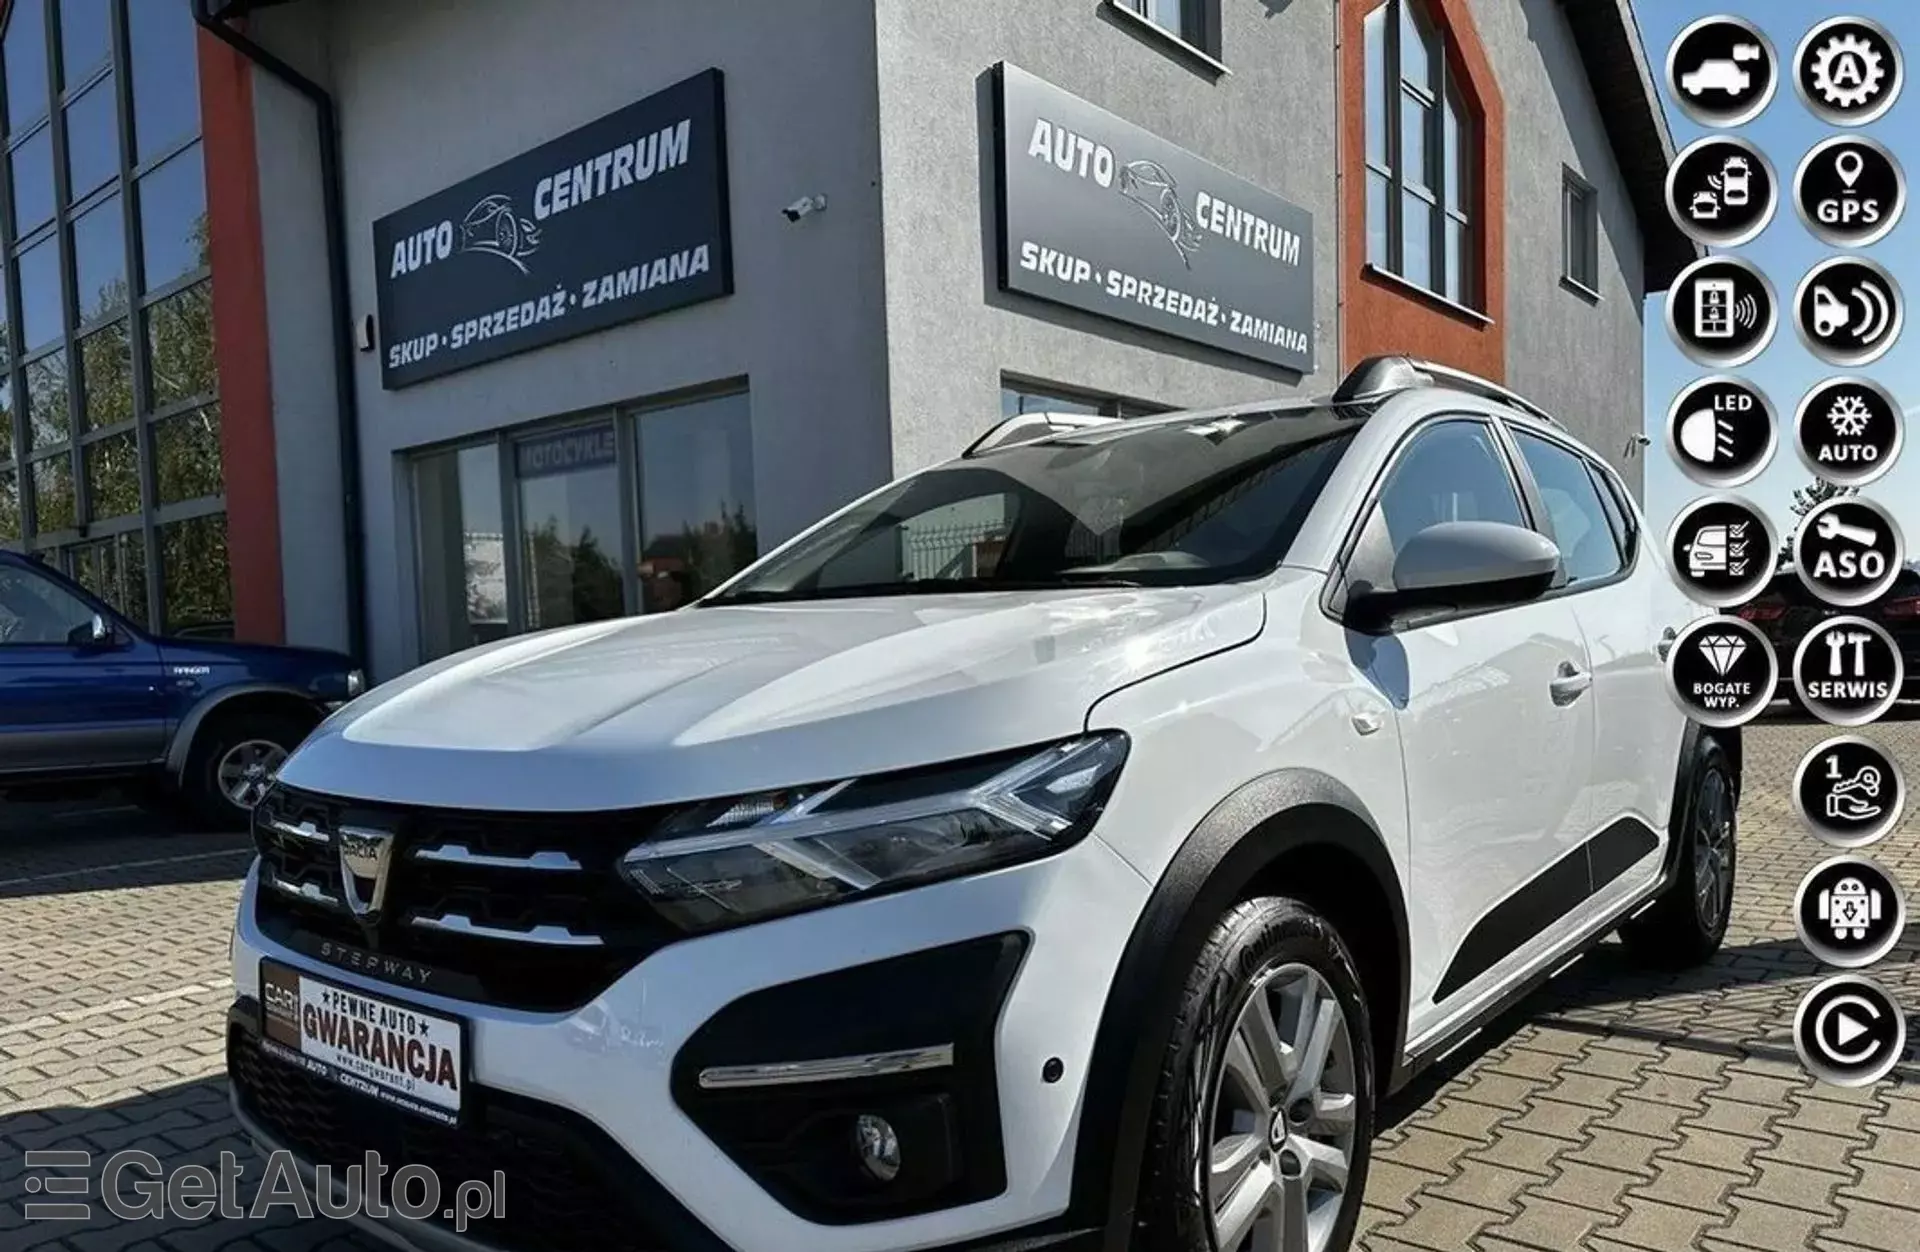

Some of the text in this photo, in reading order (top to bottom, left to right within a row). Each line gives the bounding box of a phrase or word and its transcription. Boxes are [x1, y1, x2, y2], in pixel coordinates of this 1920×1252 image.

[391, 119, 691, 278] AUTO CENTRUM
[1028, 117, 1301, 266] AUTO CENTRUM
[389, 244, 710, 369] SKUP SPRZEDAŻ ZAMIANA
[1020, 241, 1308, 354] SKUP SPRZEDAŻ ZAMIANA
[519, 432, 615, 469] MOTOCYKLE
[320, 942, 432, 984] STEPWAY
[332, 990, 376, 1023] PEWNE
[380, 1005, 416, 1036] AUTO
[302, 1003, 458, 1091] GWARANCJA
